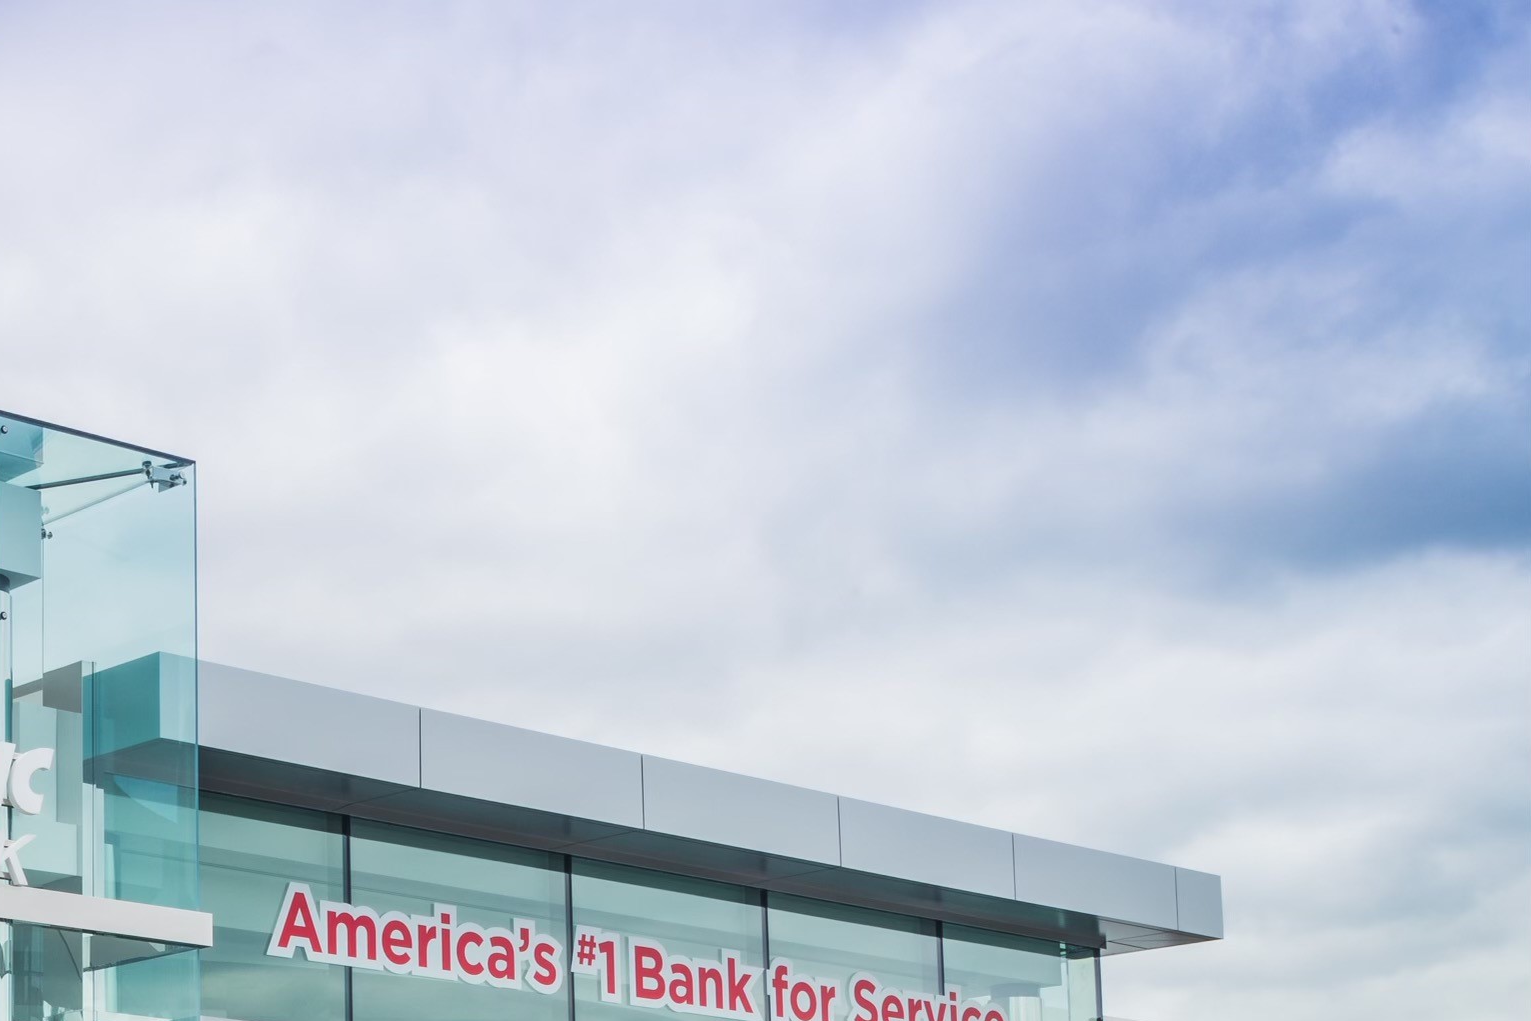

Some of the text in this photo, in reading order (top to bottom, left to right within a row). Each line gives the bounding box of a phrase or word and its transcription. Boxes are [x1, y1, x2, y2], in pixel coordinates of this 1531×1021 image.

[277, 891, 556, 986] America's
[577, 934, 615, 994] #1
[634, 946, 754, 1013] Bank
